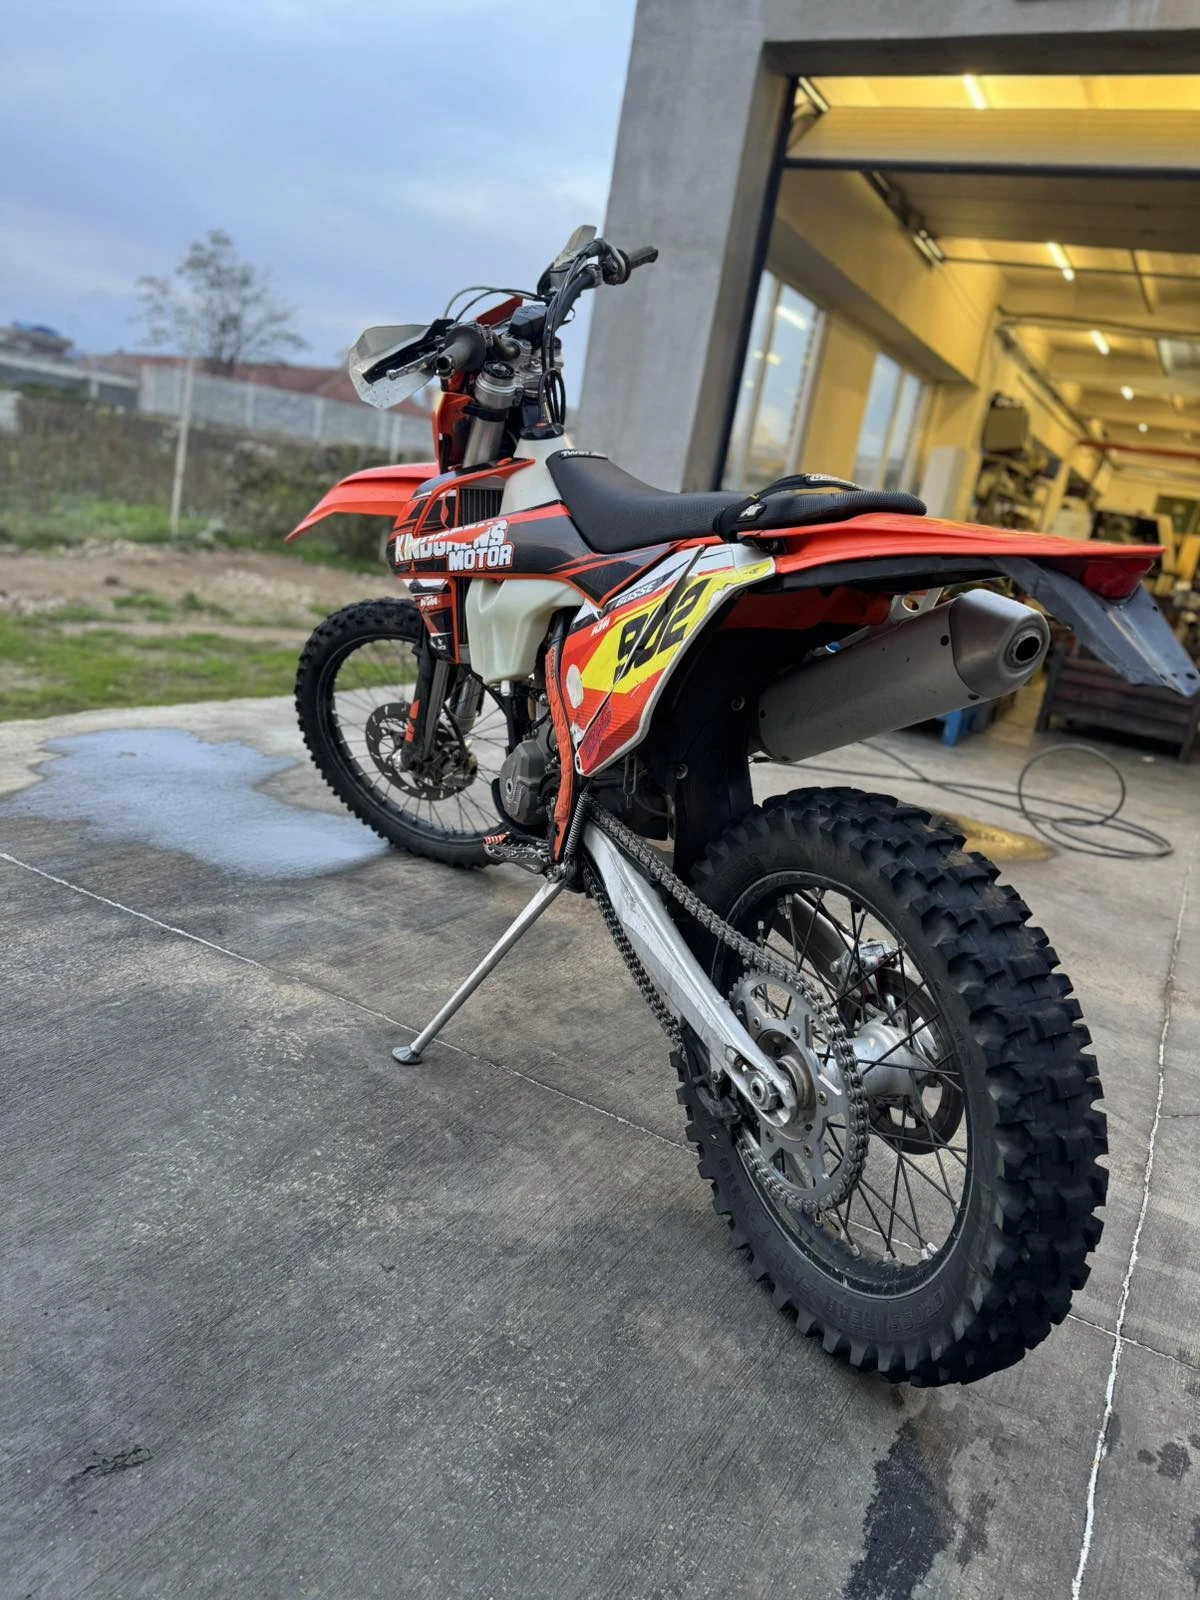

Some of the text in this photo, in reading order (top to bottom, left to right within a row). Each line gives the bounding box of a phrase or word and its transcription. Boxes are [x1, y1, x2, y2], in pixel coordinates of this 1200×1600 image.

[448, 544, 512, 571] MOTOR
[590, 616, 610, 637] KTM
[613, 577, 713, 685] 902
